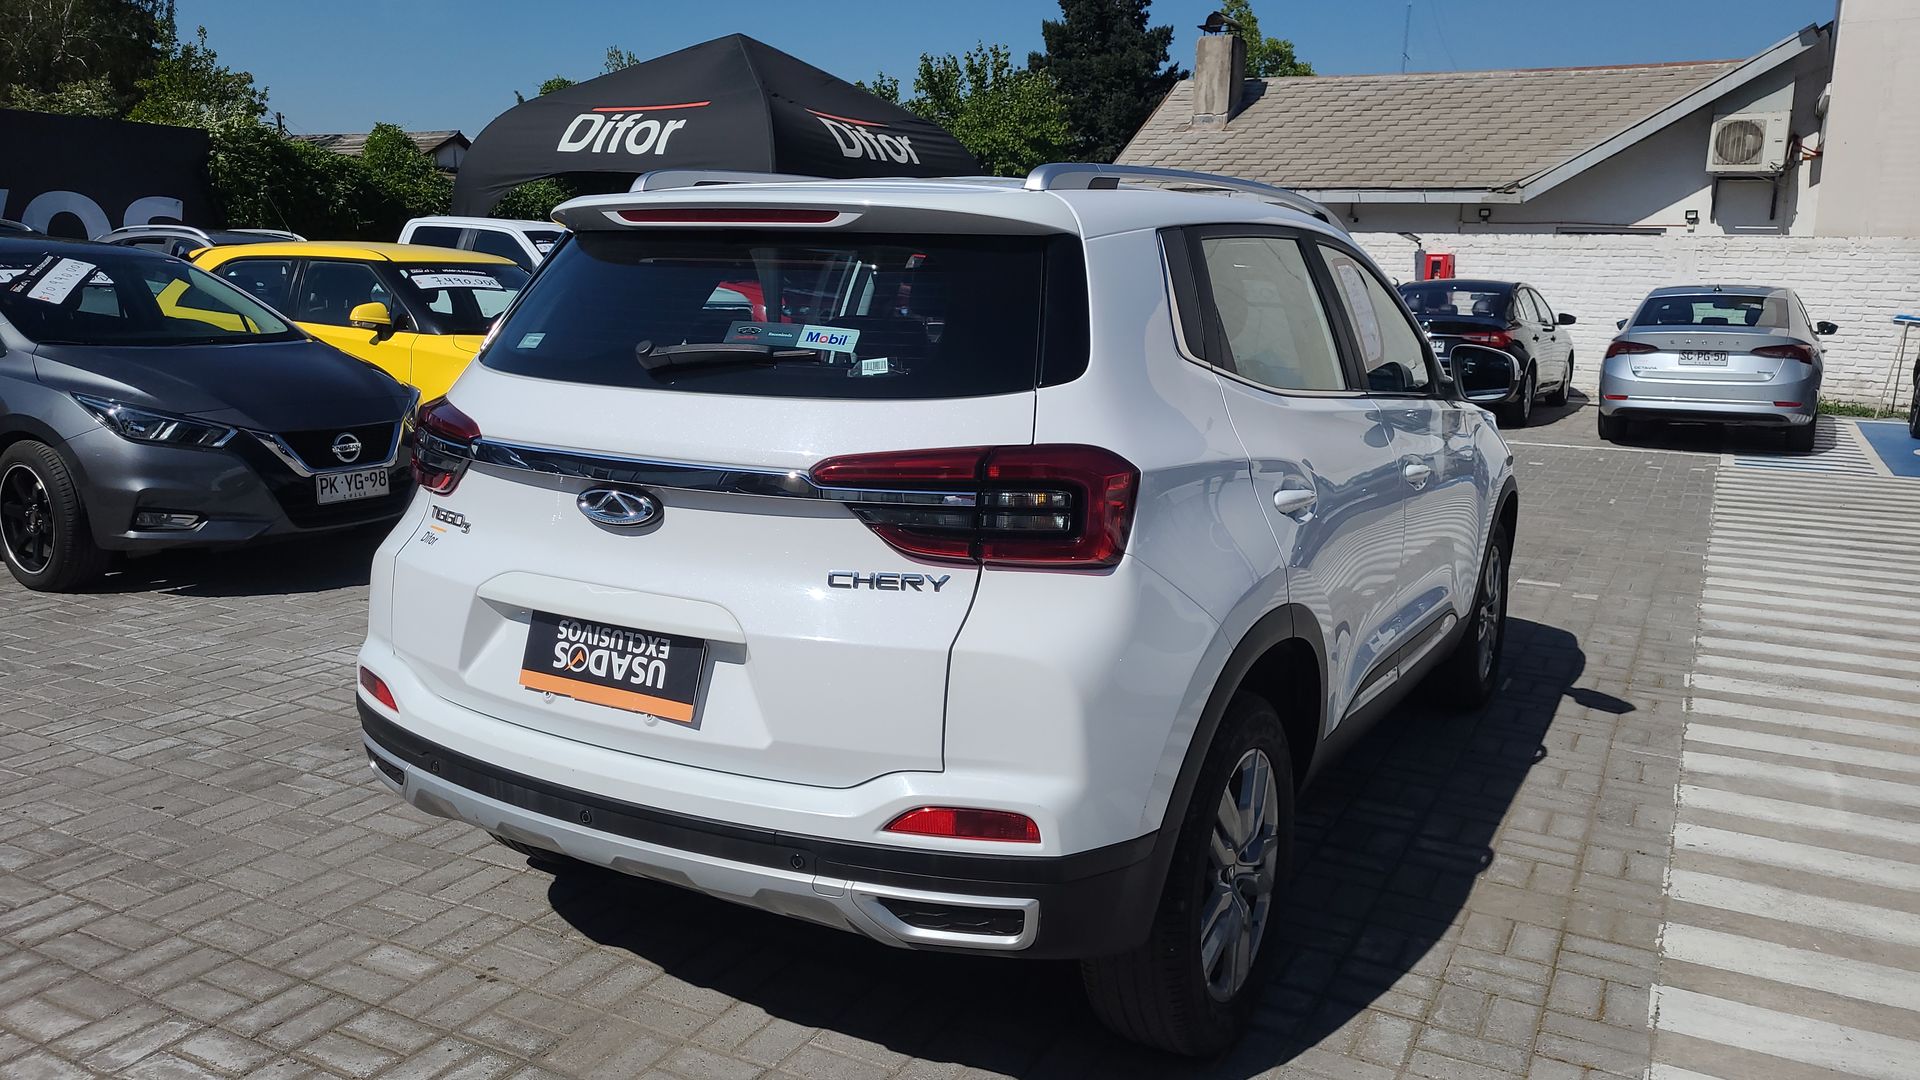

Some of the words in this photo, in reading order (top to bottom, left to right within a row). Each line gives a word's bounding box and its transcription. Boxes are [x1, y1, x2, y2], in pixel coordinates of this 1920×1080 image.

[557, 113, 687, 155] Difor
[816, 116, 920, 165] Difor
[806, 331, 848, 346] Mobil
[336, 443, 360, 451] NISSAN
[420, 531, 439, 545] Difor
[827, 570, 951, 593] CHERY
[556, 619, 671, 660] EXCLUSIVOS
[552, 641, 666, 690] USADOS
